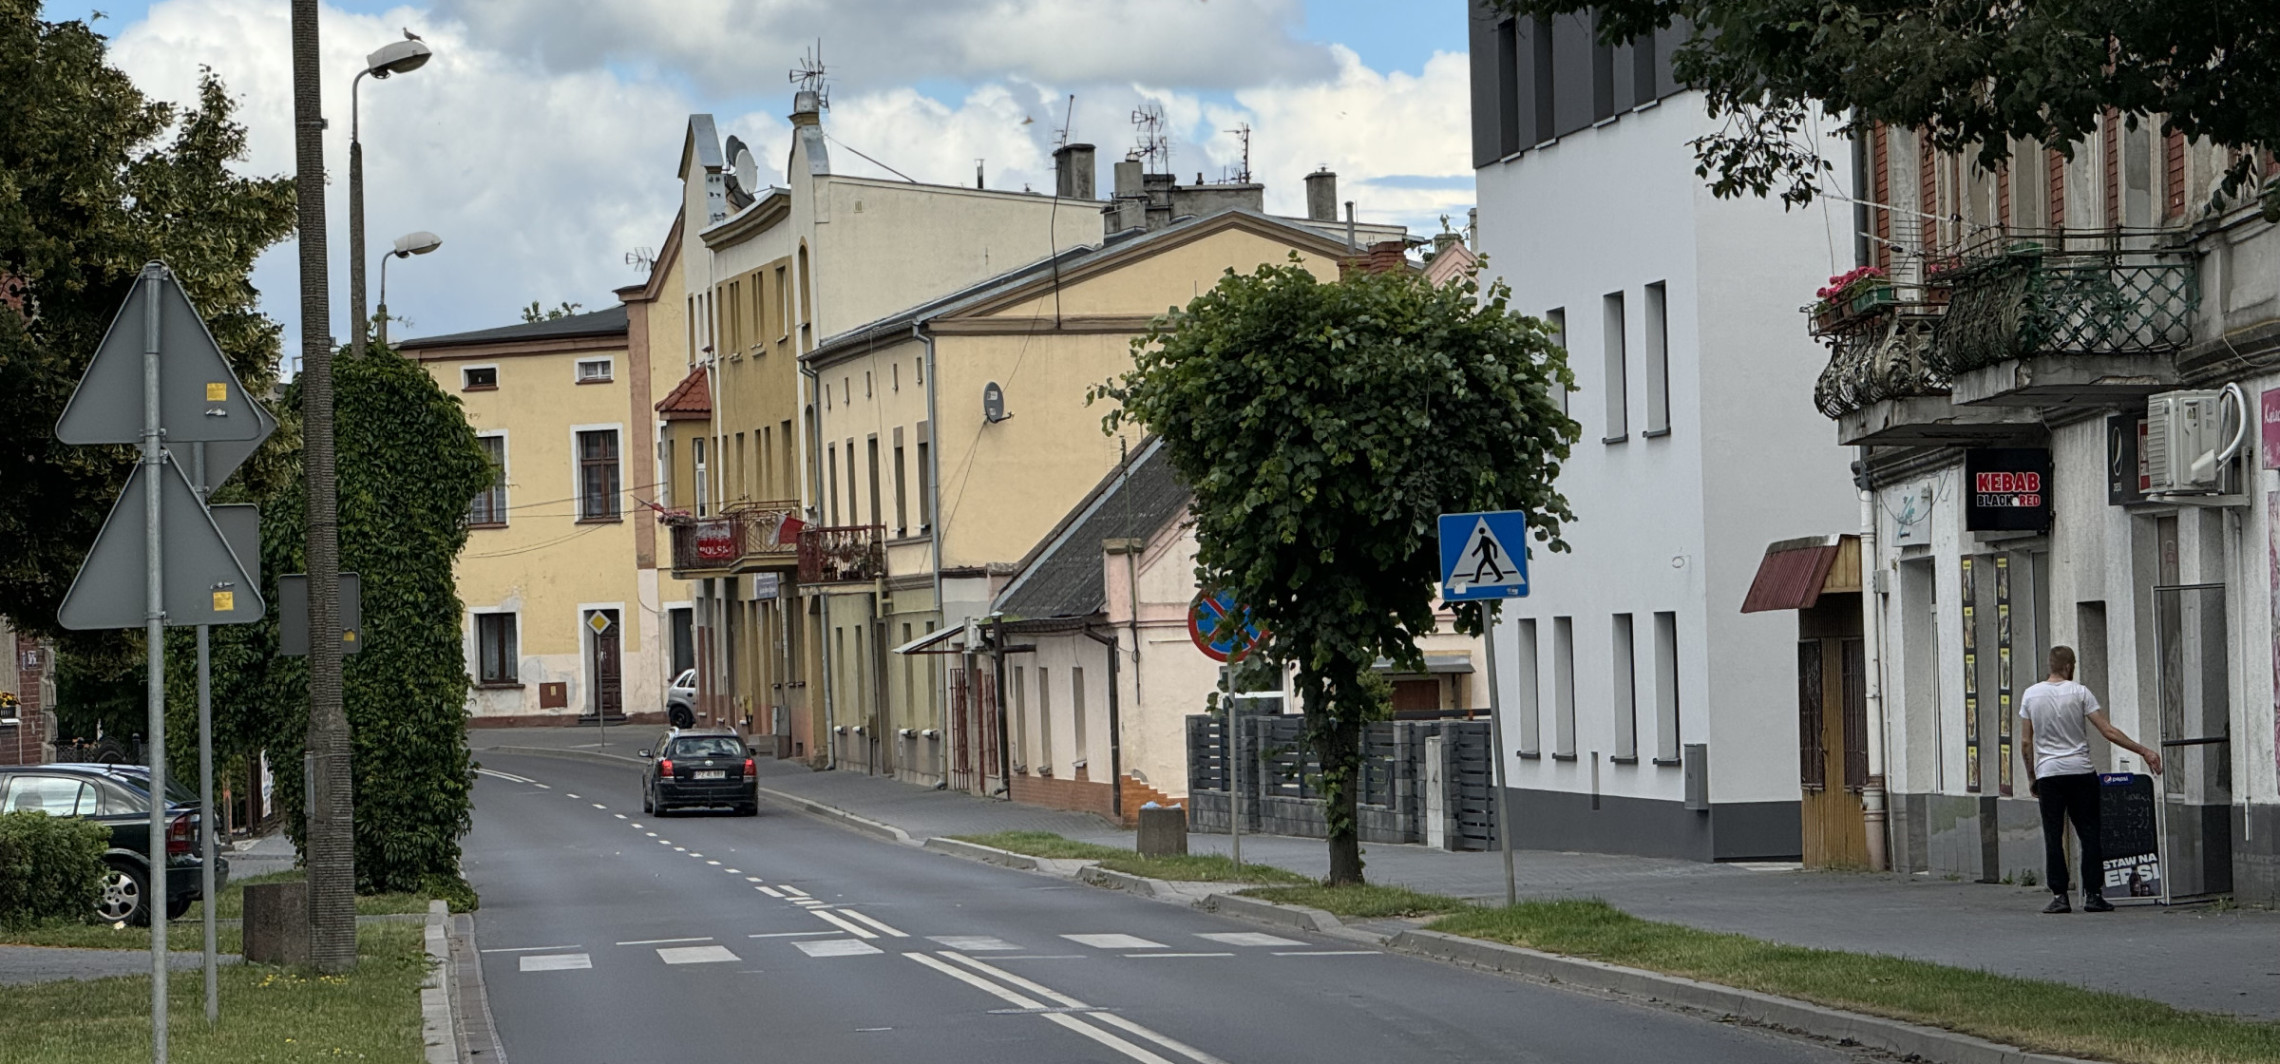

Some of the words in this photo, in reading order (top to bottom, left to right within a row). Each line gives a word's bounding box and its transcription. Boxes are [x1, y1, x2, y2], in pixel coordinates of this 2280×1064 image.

[1976, 472, 2040, 493] KEBAB
[2018, 494, 2041, 507] RED
[2102, 856, 2136, 870] STAW
[2138, 853, 2157, 863] NA
[2104, 863, 2160, 888] EPSI
